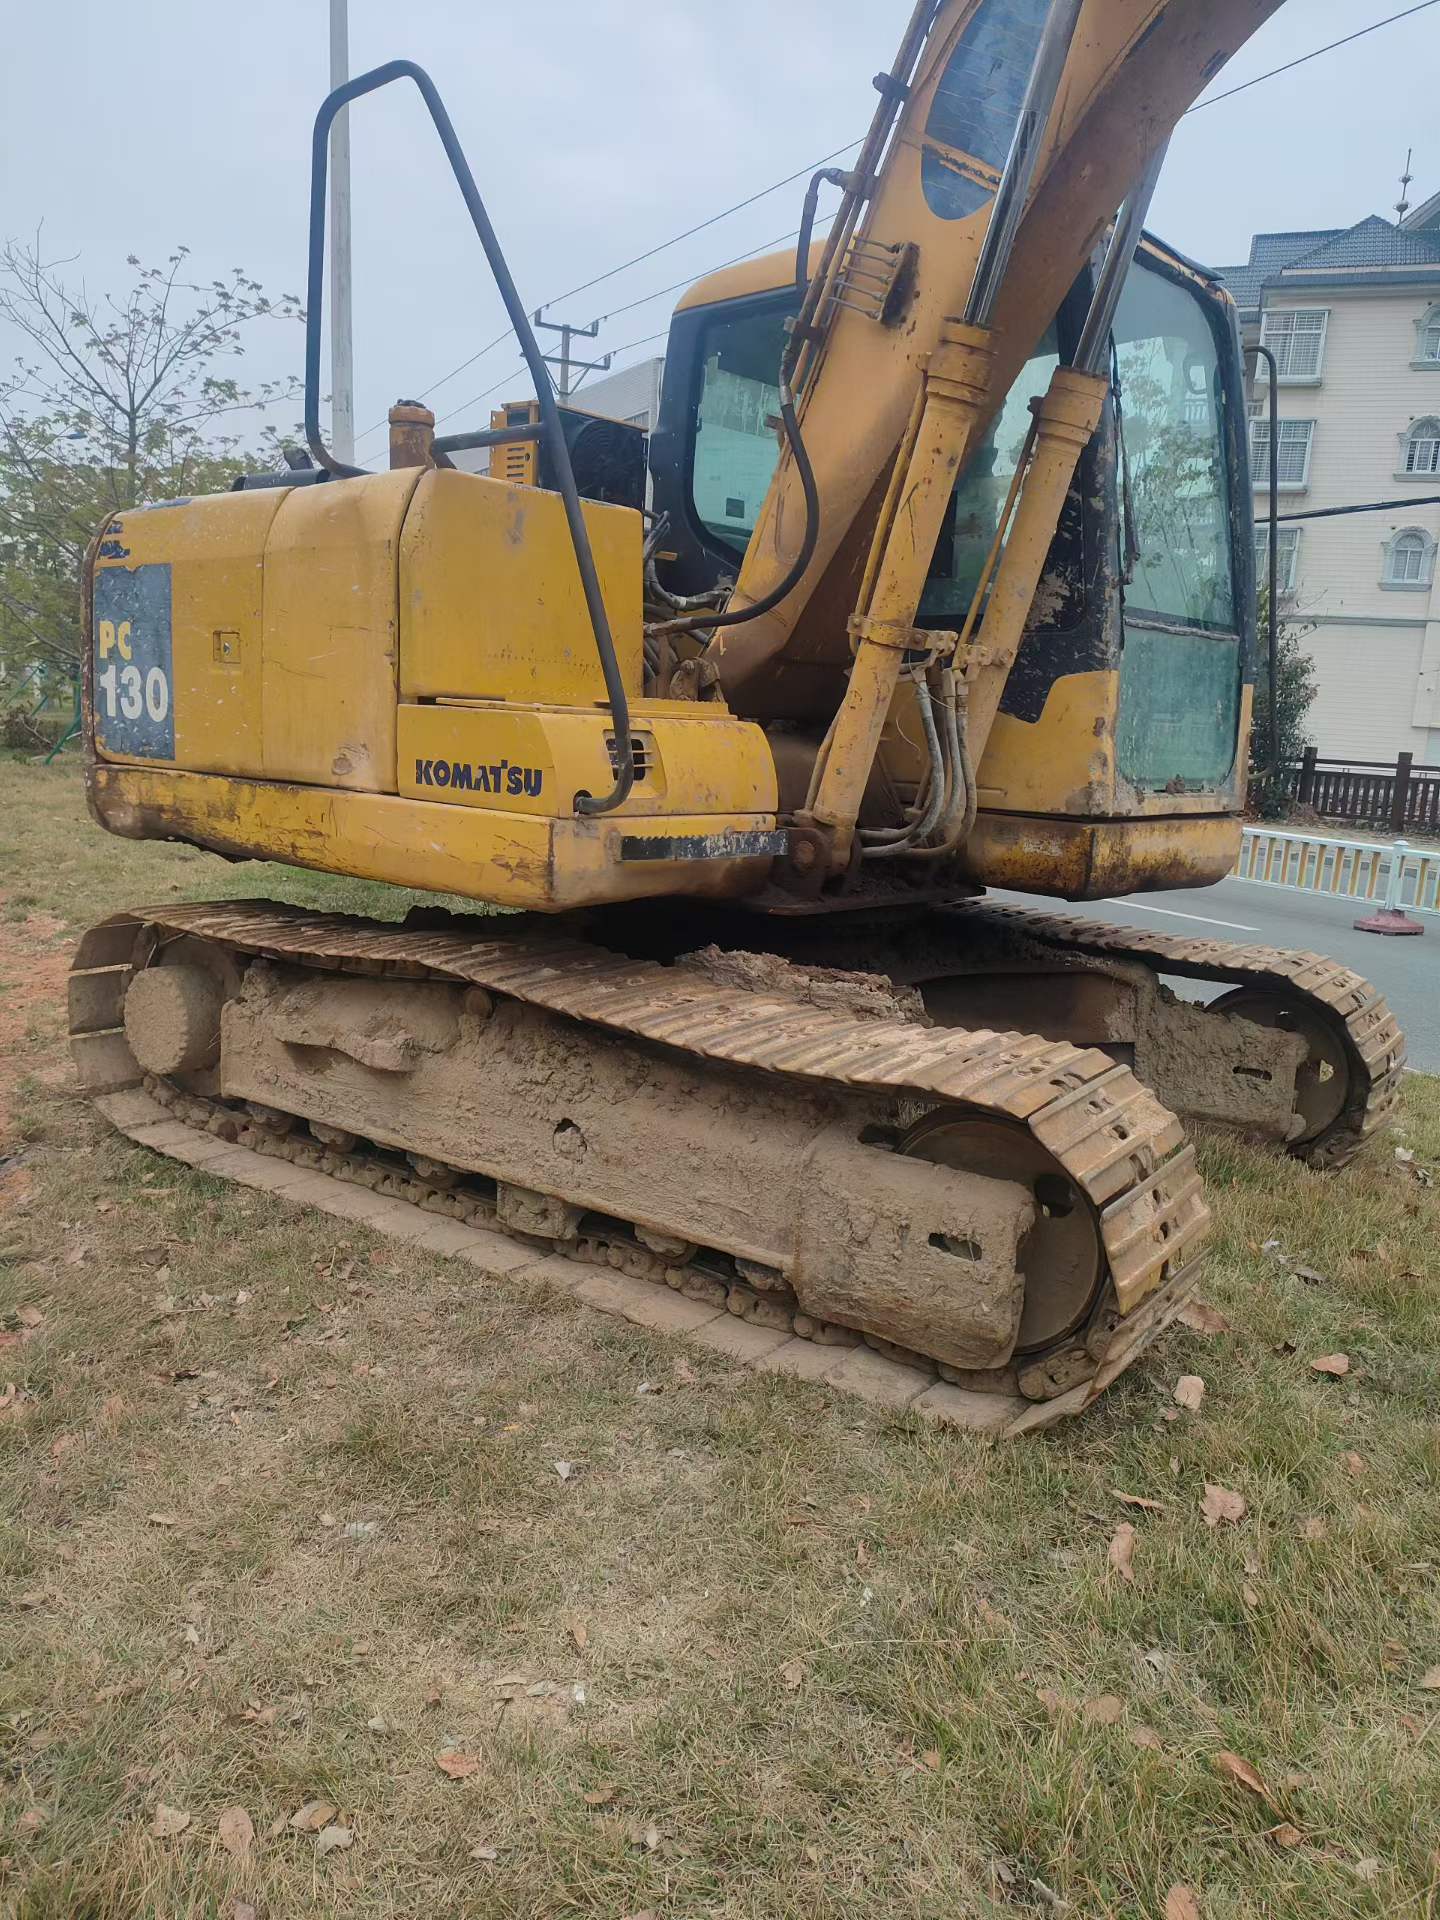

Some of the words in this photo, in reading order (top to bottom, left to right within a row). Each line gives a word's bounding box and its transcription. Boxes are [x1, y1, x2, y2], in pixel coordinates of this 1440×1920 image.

[99, 620, 132, 660] PC
[100, 664, 168, 722] 130
[415, 759, 542, 797] KOMATSU
